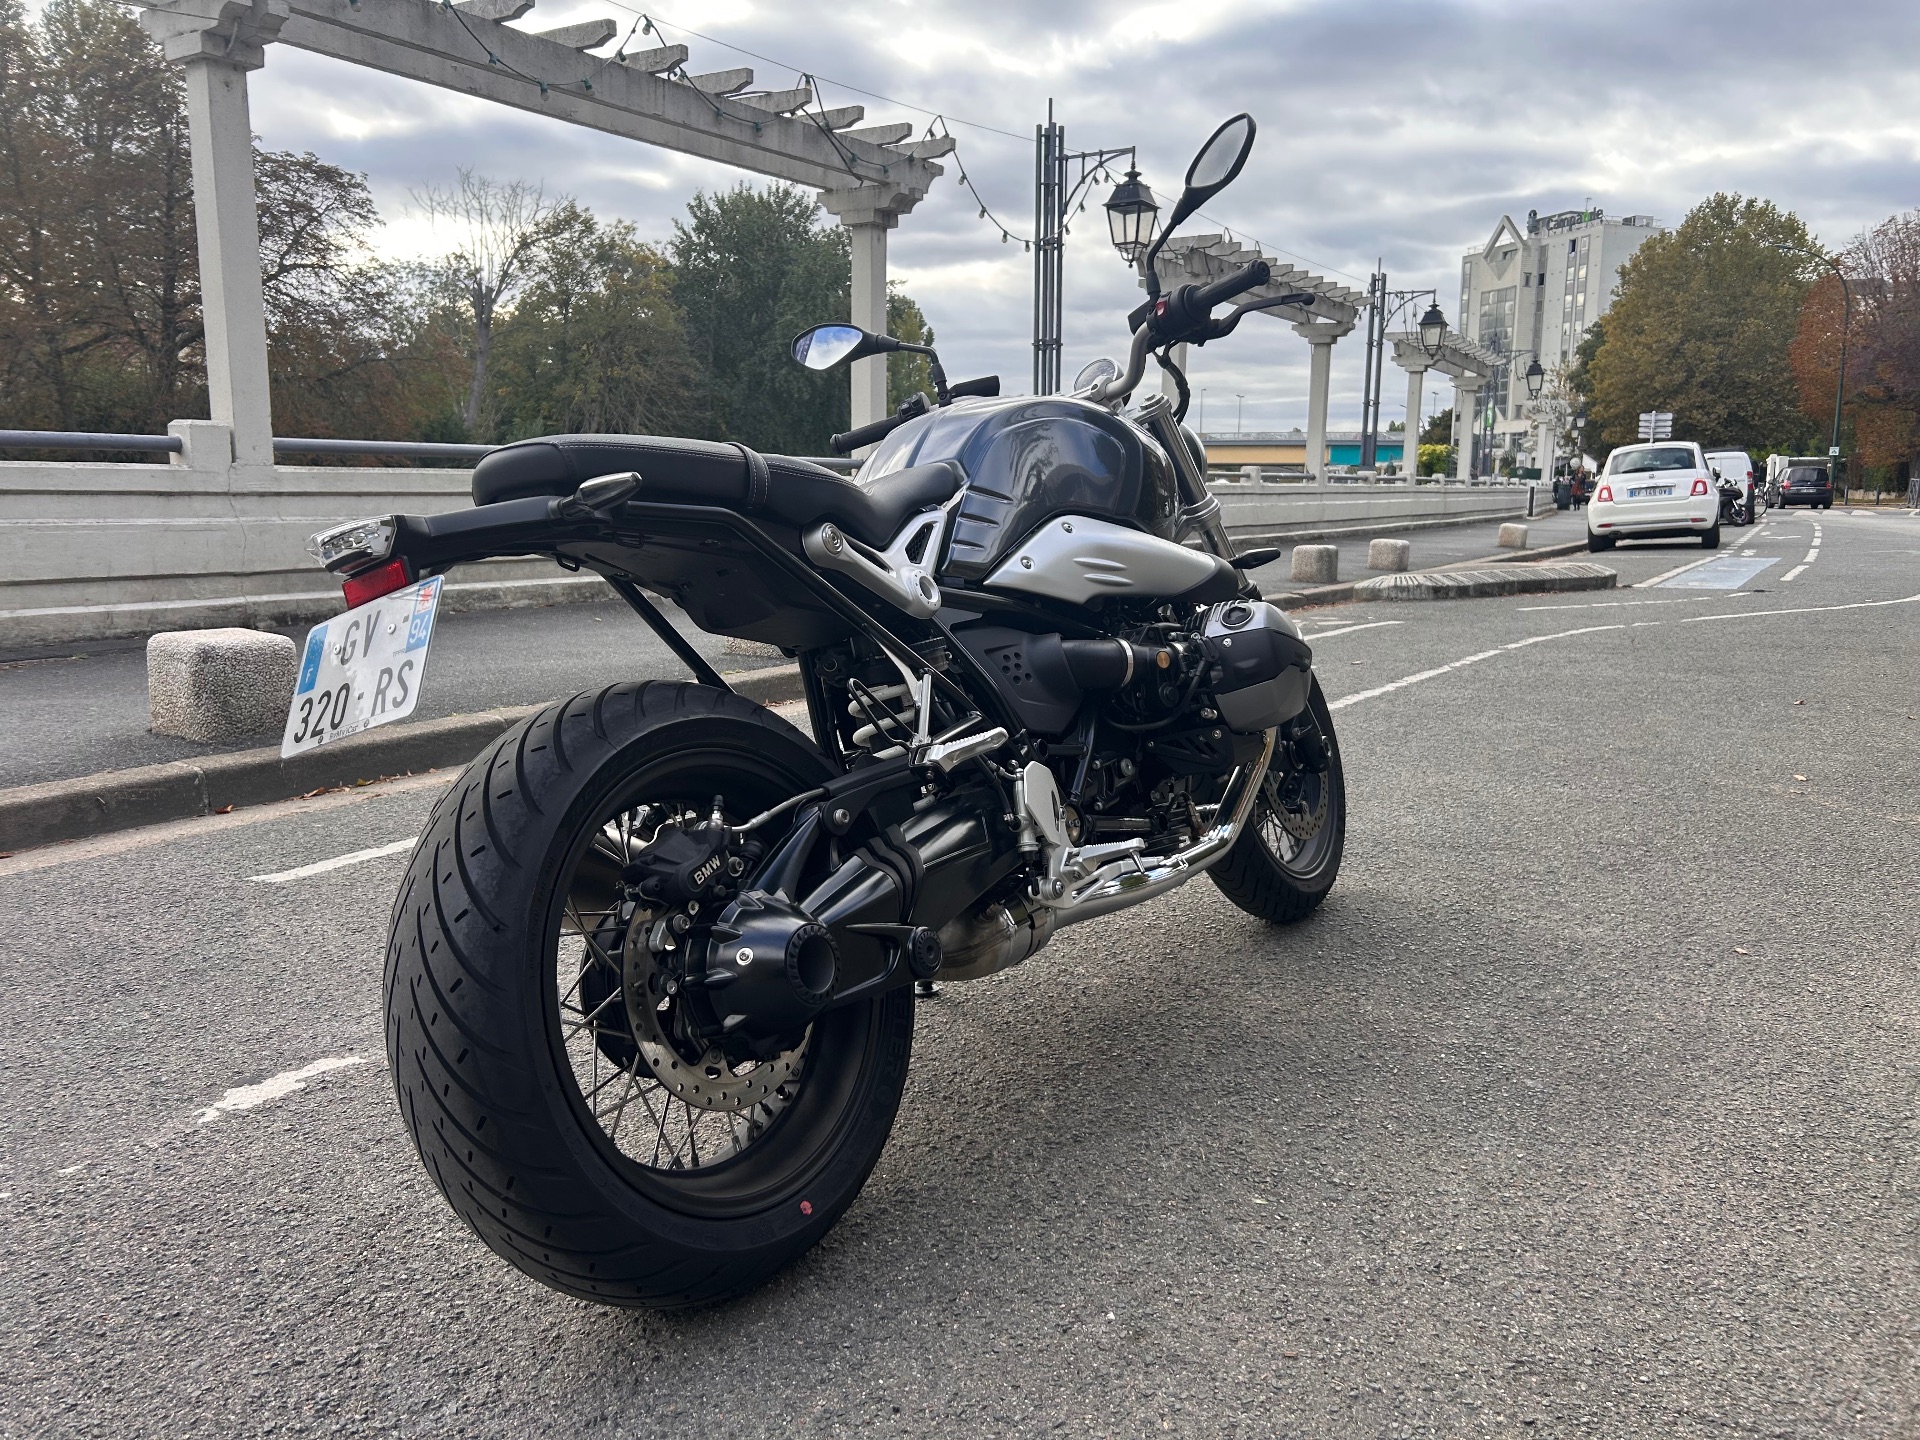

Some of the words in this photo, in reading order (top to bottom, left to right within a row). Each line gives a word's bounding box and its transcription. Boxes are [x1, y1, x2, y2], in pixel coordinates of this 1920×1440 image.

[409, 615, 429, 644] 94
[305, 667, 314, 684] F
[694, 855, 721, 885] BMW
